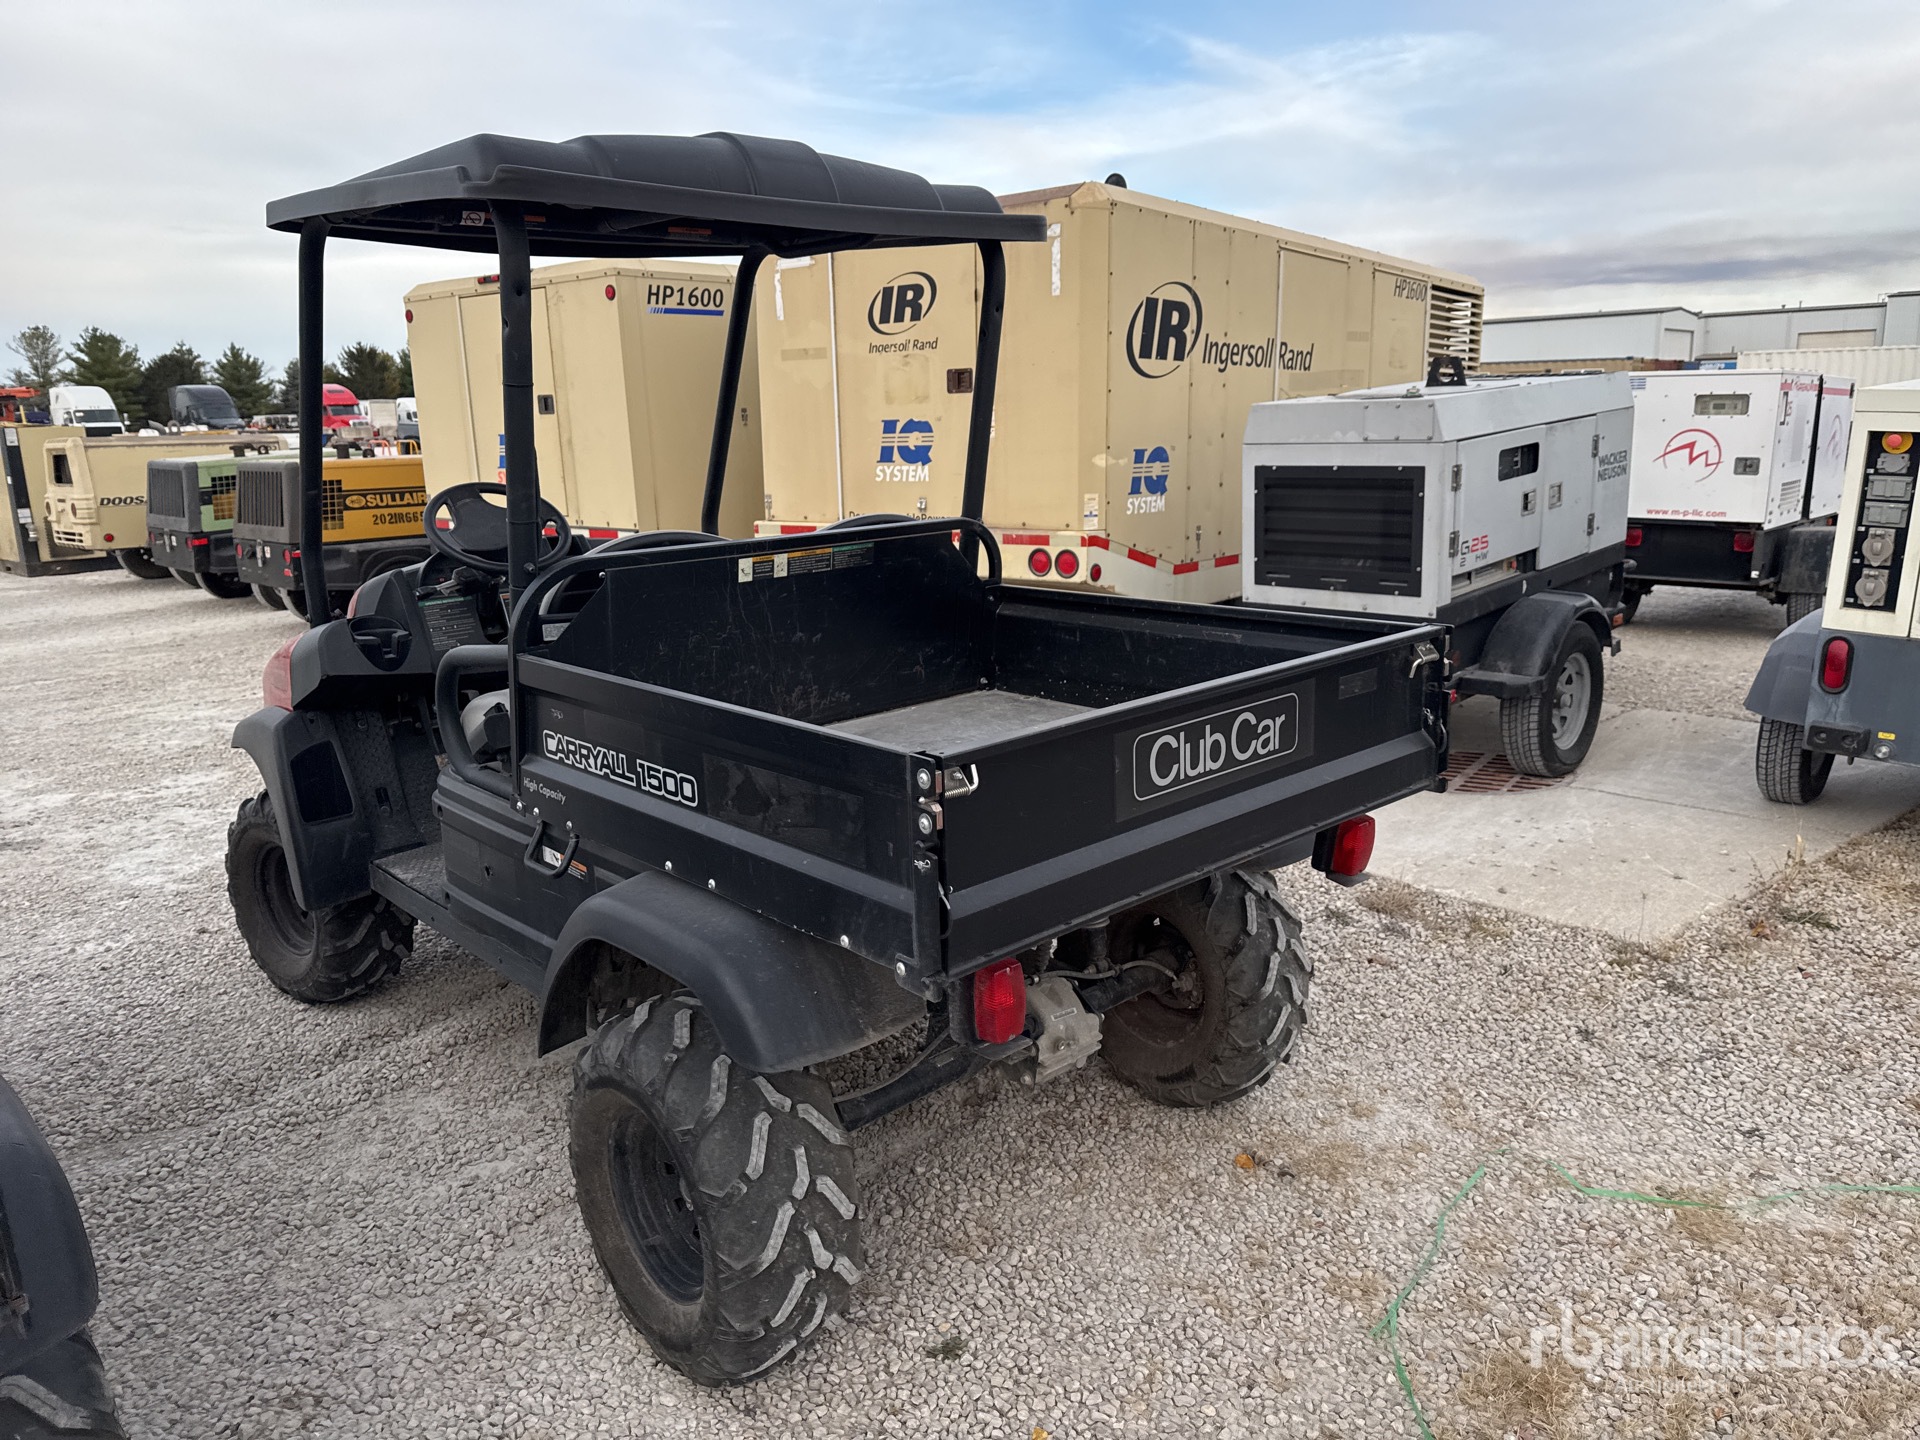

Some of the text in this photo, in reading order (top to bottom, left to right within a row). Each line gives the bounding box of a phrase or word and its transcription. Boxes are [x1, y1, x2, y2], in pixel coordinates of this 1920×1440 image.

[647, 284, 724, 308] HP1600
[1393, 277, 1427, 302] HP1600
[879, 283, 925, 325] IR
[1138, 296, 1191, 362] IR
[912, 337, 939, 351] Rand
[1202, 333, 1315, 373] Ingersoll Rand
[876, 418, 935, 466] IQ
[1127, 446, 1170, 496] IQ
[1598, 449, 1628, 468] WACKER
[875, 465, 930, 482] SYSTEM
[1597, 463, 1628, 482] NEUSON
[99, 495, 148, 506] DOOS
[366, 492, 428, 507] SULLAIR
[1126, 495, 1166, 515] SYSTEM
[1149, 711, 1286, 787] Club Car
[543, 729, 698, 807] CARRYALL 1500
[523, 776, 567, 805] High Capacity
